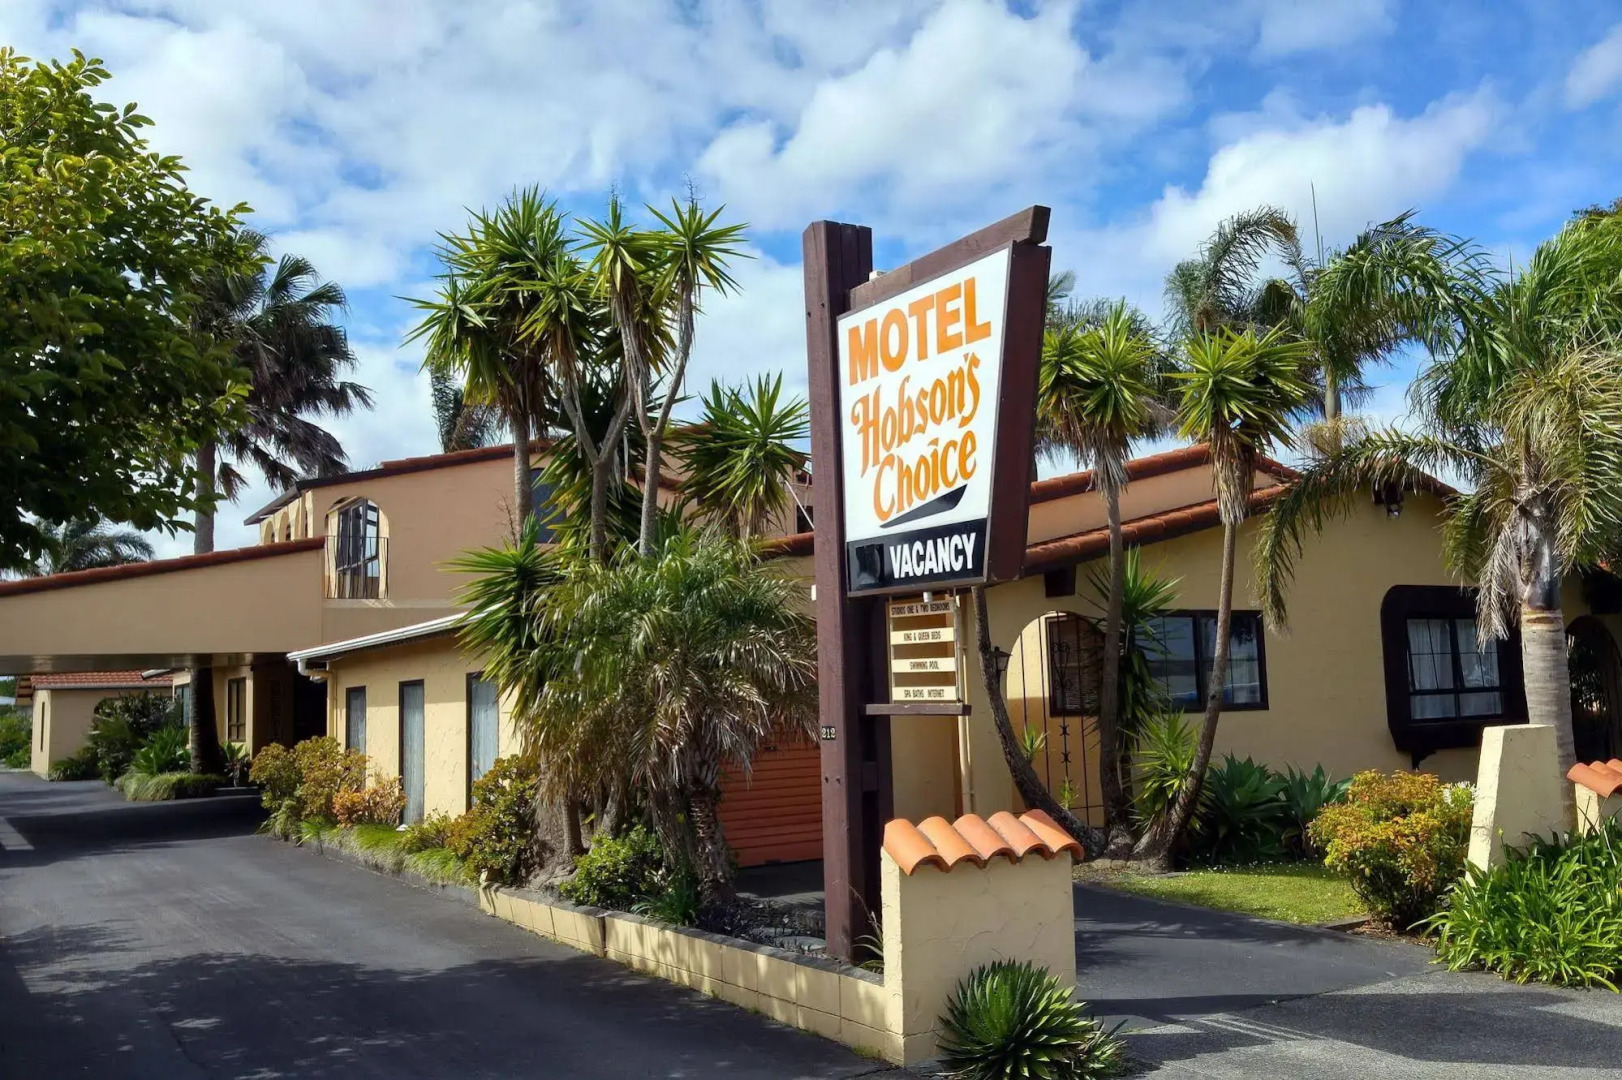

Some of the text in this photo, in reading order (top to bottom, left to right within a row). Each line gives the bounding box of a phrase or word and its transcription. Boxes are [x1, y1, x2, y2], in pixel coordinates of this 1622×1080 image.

[848, 277, 991, 386] MOTEL
[851, 352, 981, 478] Hobson's
[873, 430, 977, 521] Choice
[889, 532, 976, 579] VACANCY
[891, 605, 906, 616] STUDIOS
[907, 604, 915, 614] ONE
[920, 602, 929, 613] TWO
[930, 601, 950, 612] BEDROOMS
[904, 632, 912, 641] KING
[918, 631, 930, 641] QUEEN
[931, 630, 941, 640] BEDS
[910, 660, 939, 670] SWIMMING POOL
[912, 688, 925, 698] BATHS
[927, 688, 945, 698] INTERNET
[821, 727, 836, 739] 212
